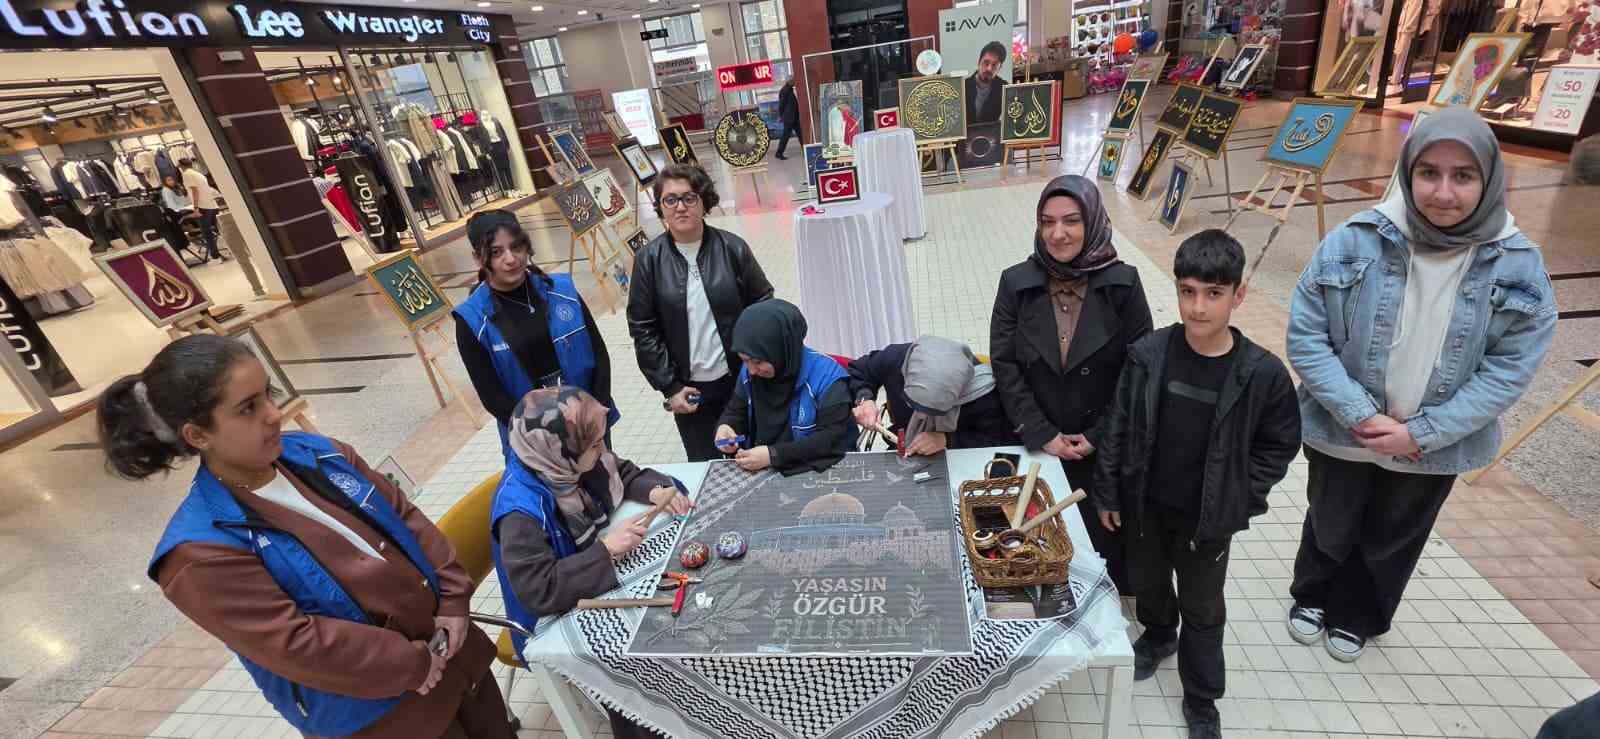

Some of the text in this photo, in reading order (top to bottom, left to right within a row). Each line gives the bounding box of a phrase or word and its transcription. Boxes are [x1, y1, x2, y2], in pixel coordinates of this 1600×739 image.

[0, 0, 208, 36] Lufian
[234, 4, 305, 37] Lee
[324, 10, 446, 42] Wrangler
[958, 14, 1006, 31] AVVA
[469, 29, 491, 42] City
[354, 174, 385, 238] Lufian
[792, 576, 888, 595] YAŞASIN
[793, 593, 887, 616] ÖZGÜR
